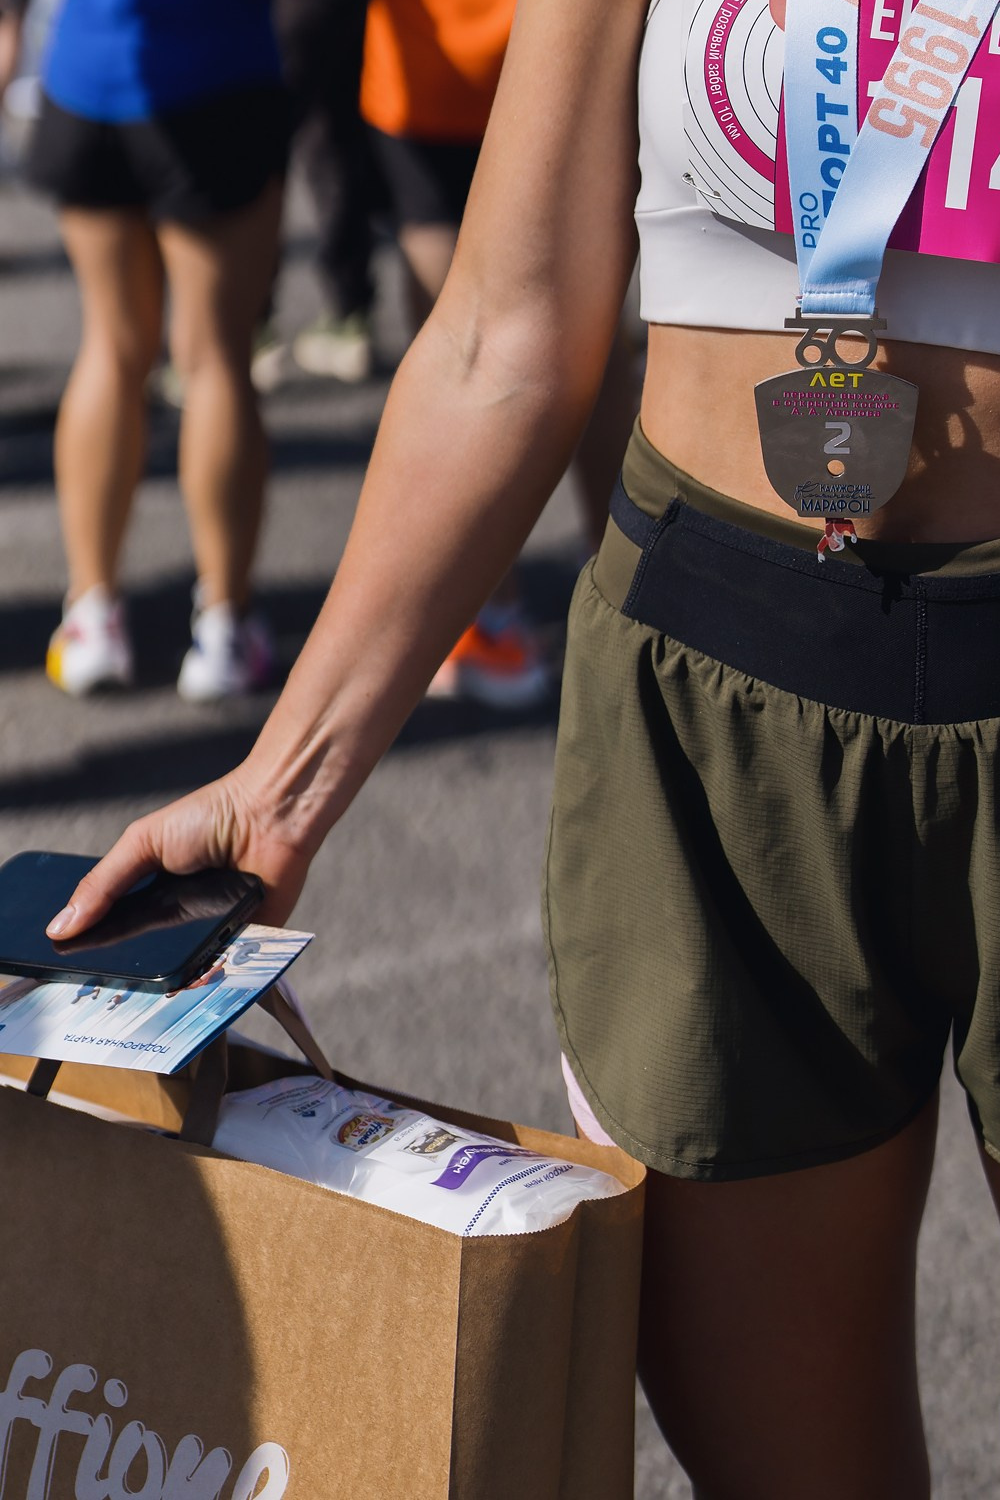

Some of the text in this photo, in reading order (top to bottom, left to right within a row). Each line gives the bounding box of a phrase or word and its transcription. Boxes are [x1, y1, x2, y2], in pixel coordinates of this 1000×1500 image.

[709, 8, 732, 60] розовый
[816, 26, 848, 85] 40
[708, 64, 723, 96] забег
[717, 106, 730, 122] 10
[725, 121, 741, 140] км
[799, 192, 820, 248] PRO
[795, 327, 878, 369] 60
[783, 391, 889, 401] первого выхода
[784, 400, 849, 408] открытый
[823, 422, 851, 454] 2
[801, 499, 870, 513] МАРАФОН
[64, 1033, 171, 1054] ПОДАРОЧНАЯ КАРТА
[0, 1349, 289, 1500] ffione
